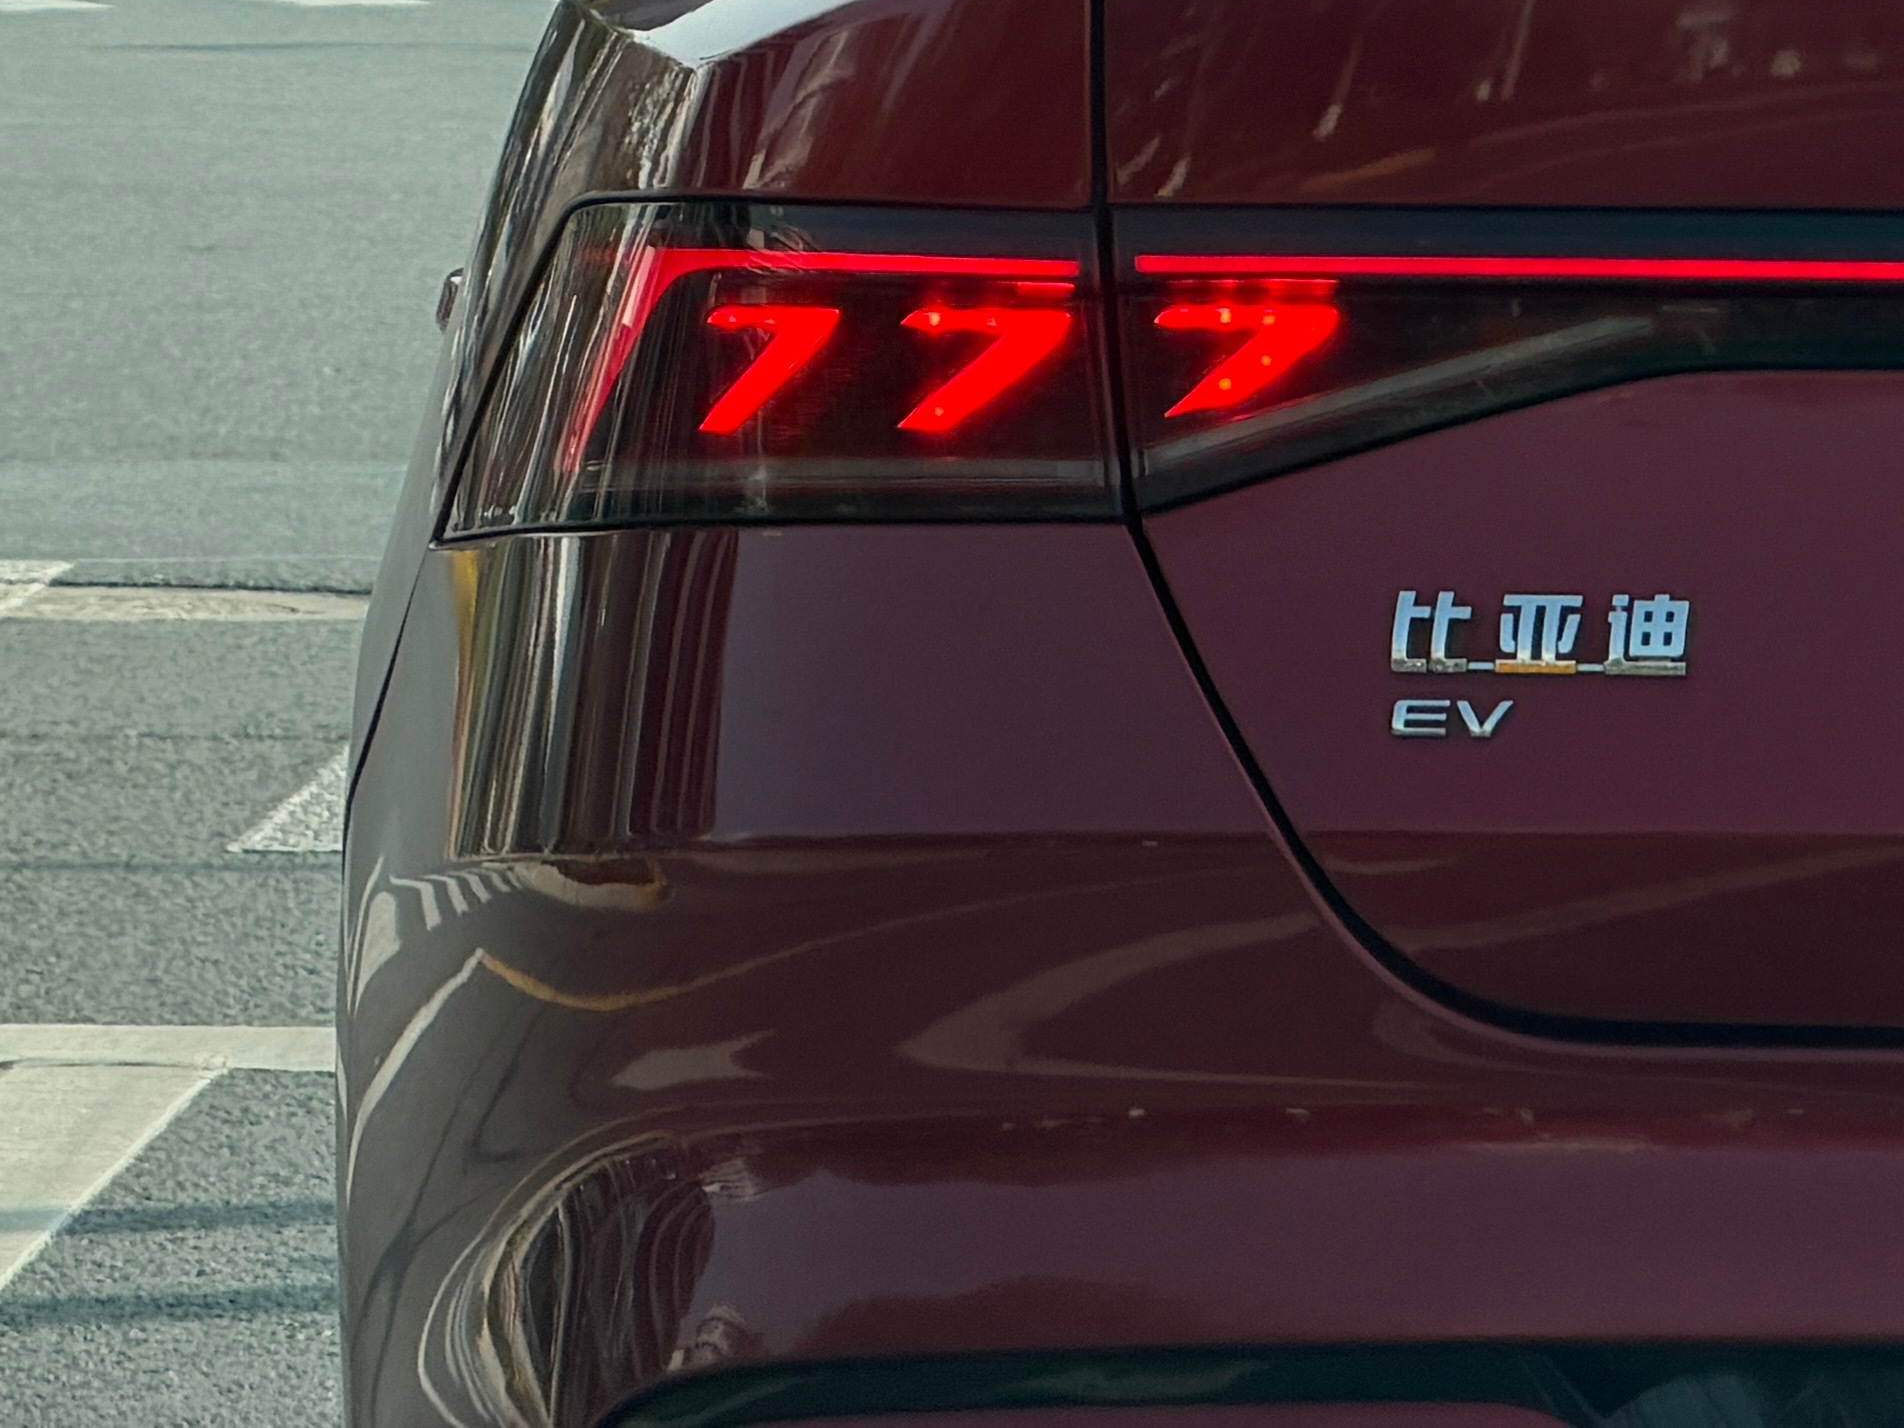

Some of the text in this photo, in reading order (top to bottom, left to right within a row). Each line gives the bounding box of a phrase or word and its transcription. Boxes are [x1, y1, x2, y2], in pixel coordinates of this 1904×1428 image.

[1391, 591, 1690, 674] 比亚迪
[1391, 699, 1514, 736] EV
